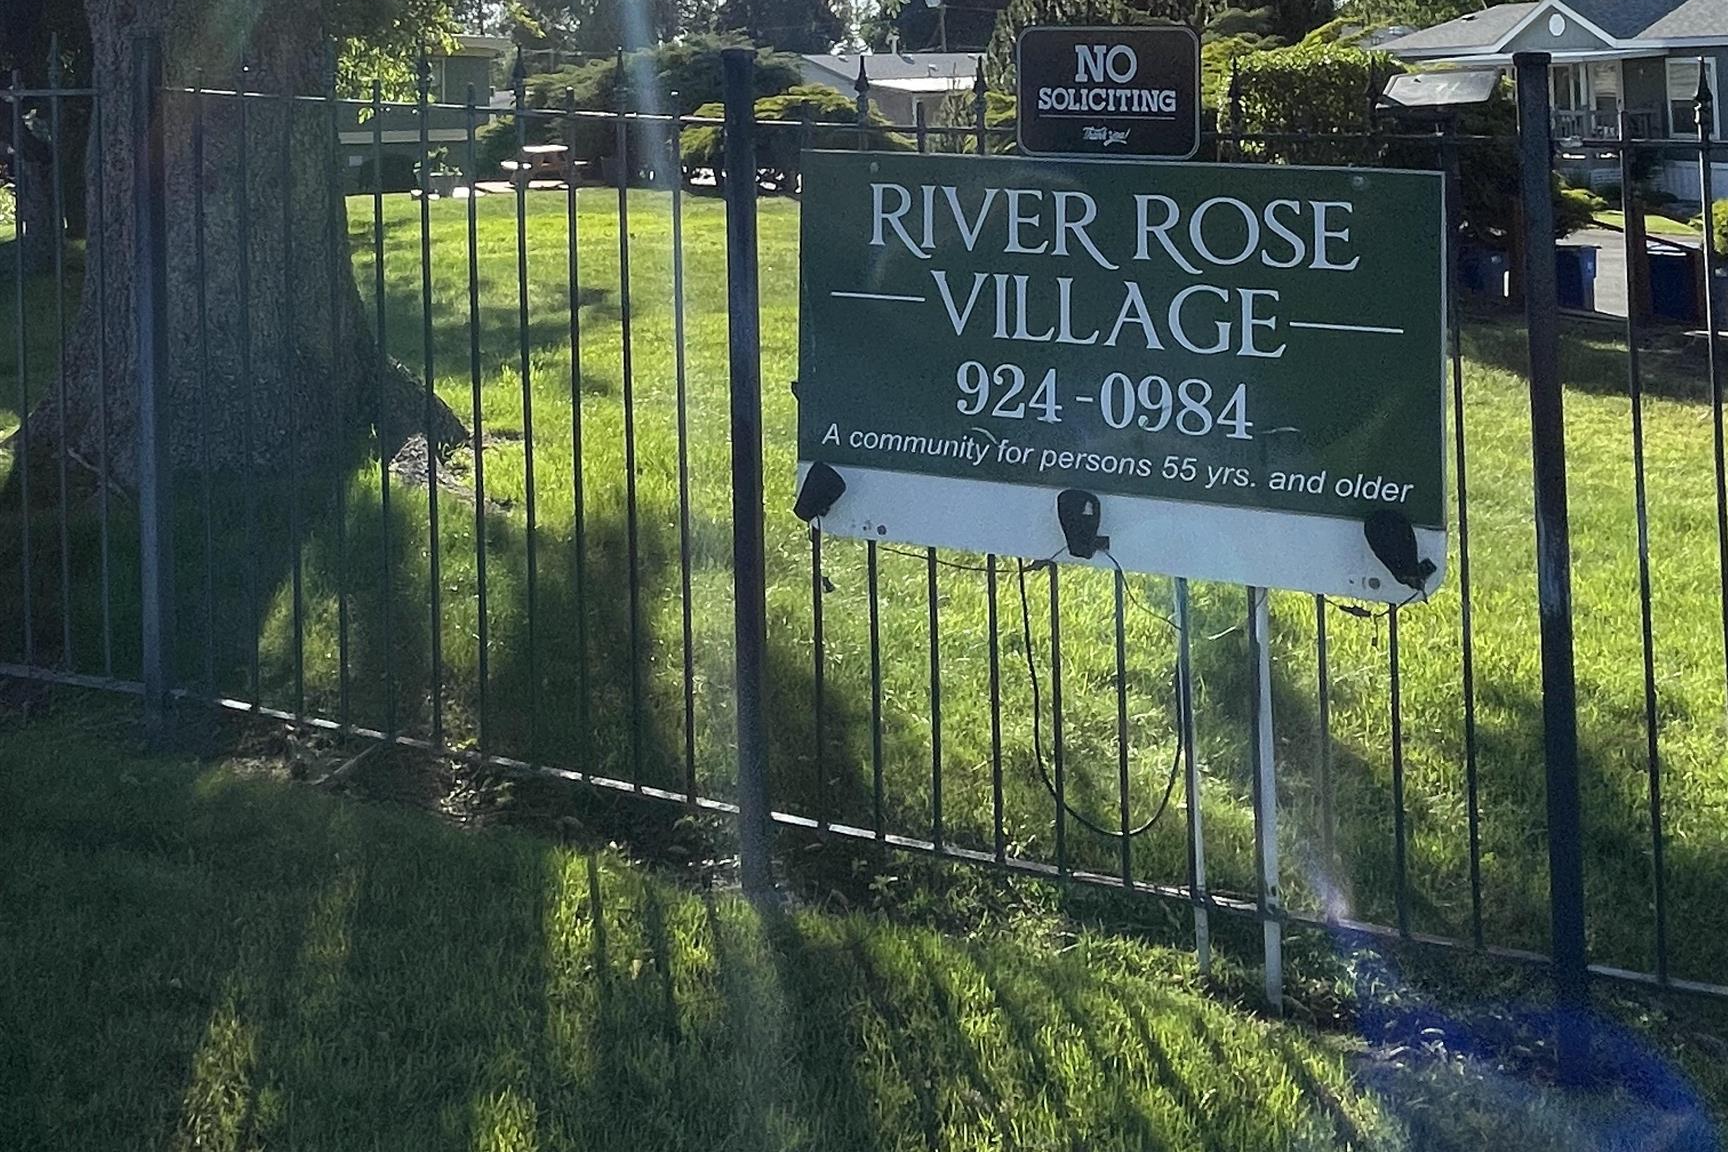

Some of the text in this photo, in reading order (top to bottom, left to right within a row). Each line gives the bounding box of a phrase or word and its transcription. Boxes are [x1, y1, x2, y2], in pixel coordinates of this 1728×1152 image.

[1038, 88, 1177, 112] SOLICITING
[1075, 45, 1138, 83] NO
[868, 183, 1360, 275] RIVER ROSE
[930, 269, 1287, 358] VILLAGE
[821, 423, 1414, 503] A community for persons 55 yrs. and older
